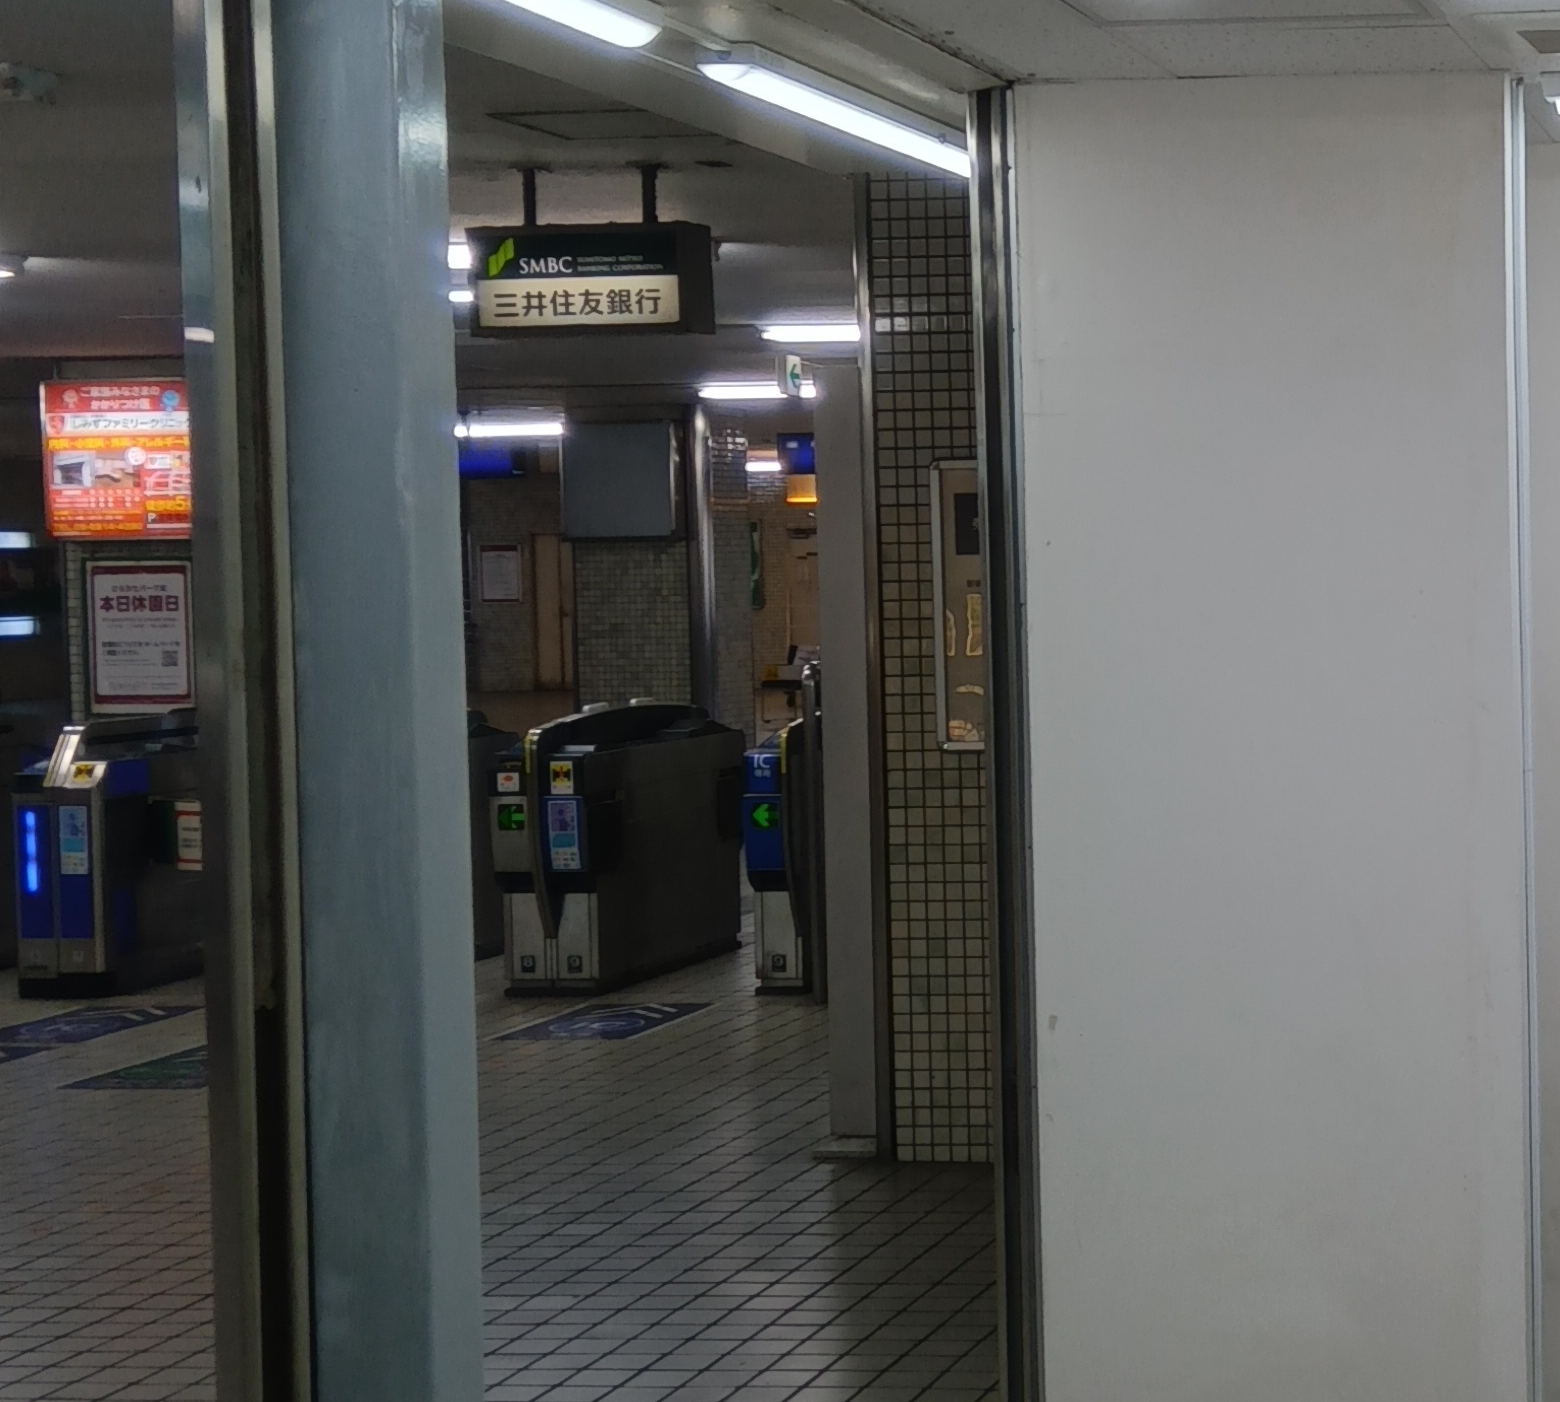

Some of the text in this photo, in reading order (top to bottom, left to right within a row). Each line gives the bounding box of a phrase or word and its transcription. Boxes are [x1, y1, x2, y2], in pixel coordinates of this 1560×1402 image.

[518, 256, 573, 274] SMBC
[494, 288, 662, 318] 三井住友銀行
[753, 754, 770, 768] IC
[523, 956, 533, 967] 8
